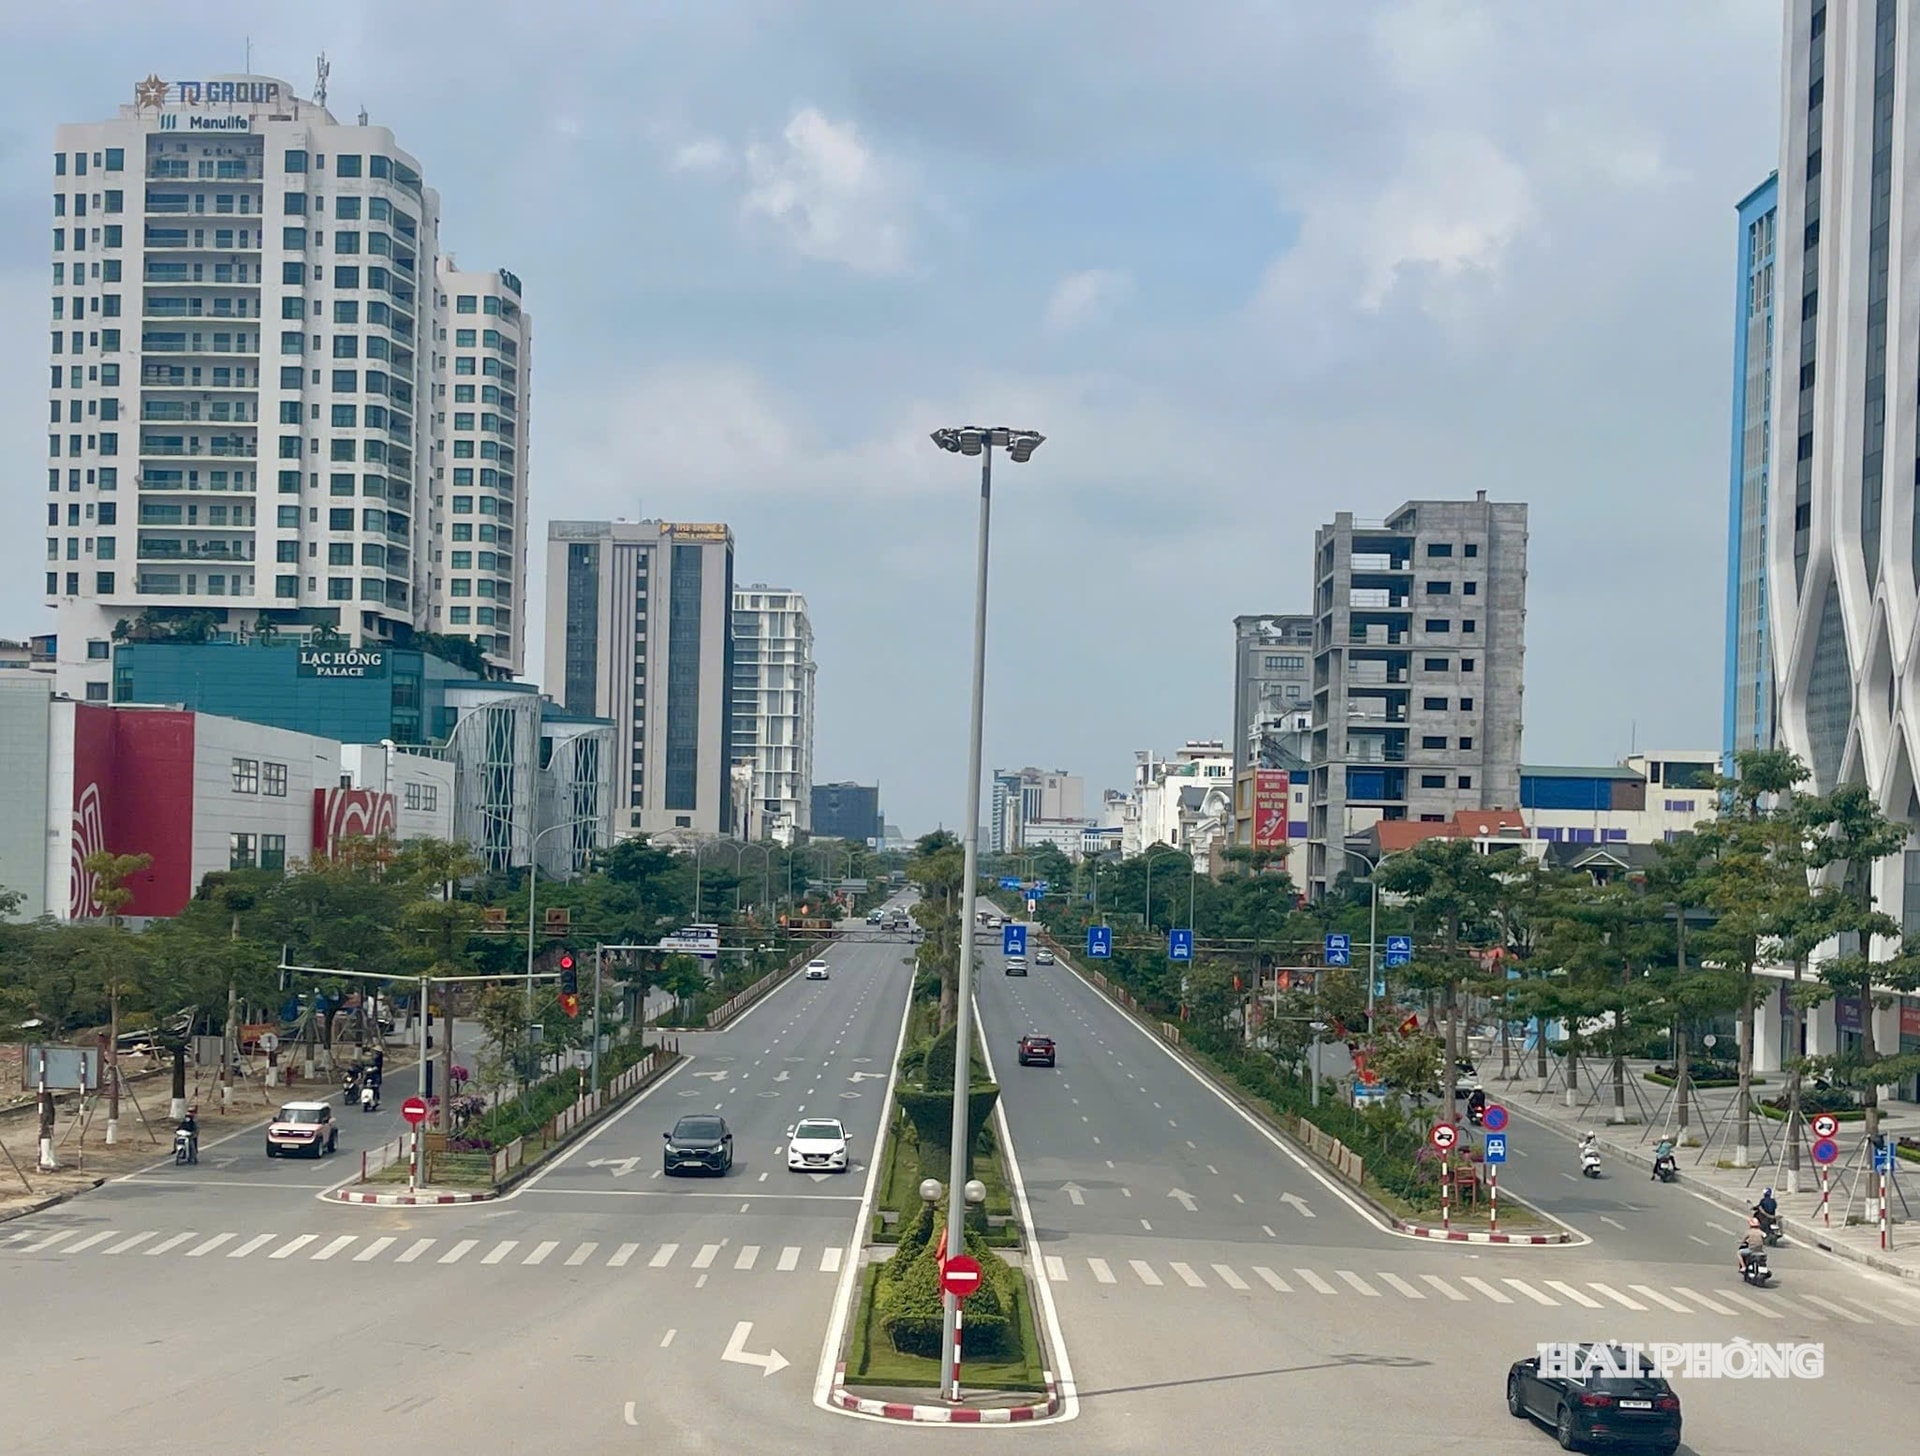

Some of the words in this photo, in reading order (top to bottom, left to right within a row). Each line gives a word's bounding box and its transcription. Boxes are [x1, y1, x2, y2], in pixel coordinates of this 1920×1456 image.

[207, 82, 279, 103] GROUP
[190, 115, 248, 129] Manulife
[301, 652, 331, 668] LẠC
[334, 649, 382, 666] HỒNG
[316, 667, 364, 676] PALACE
